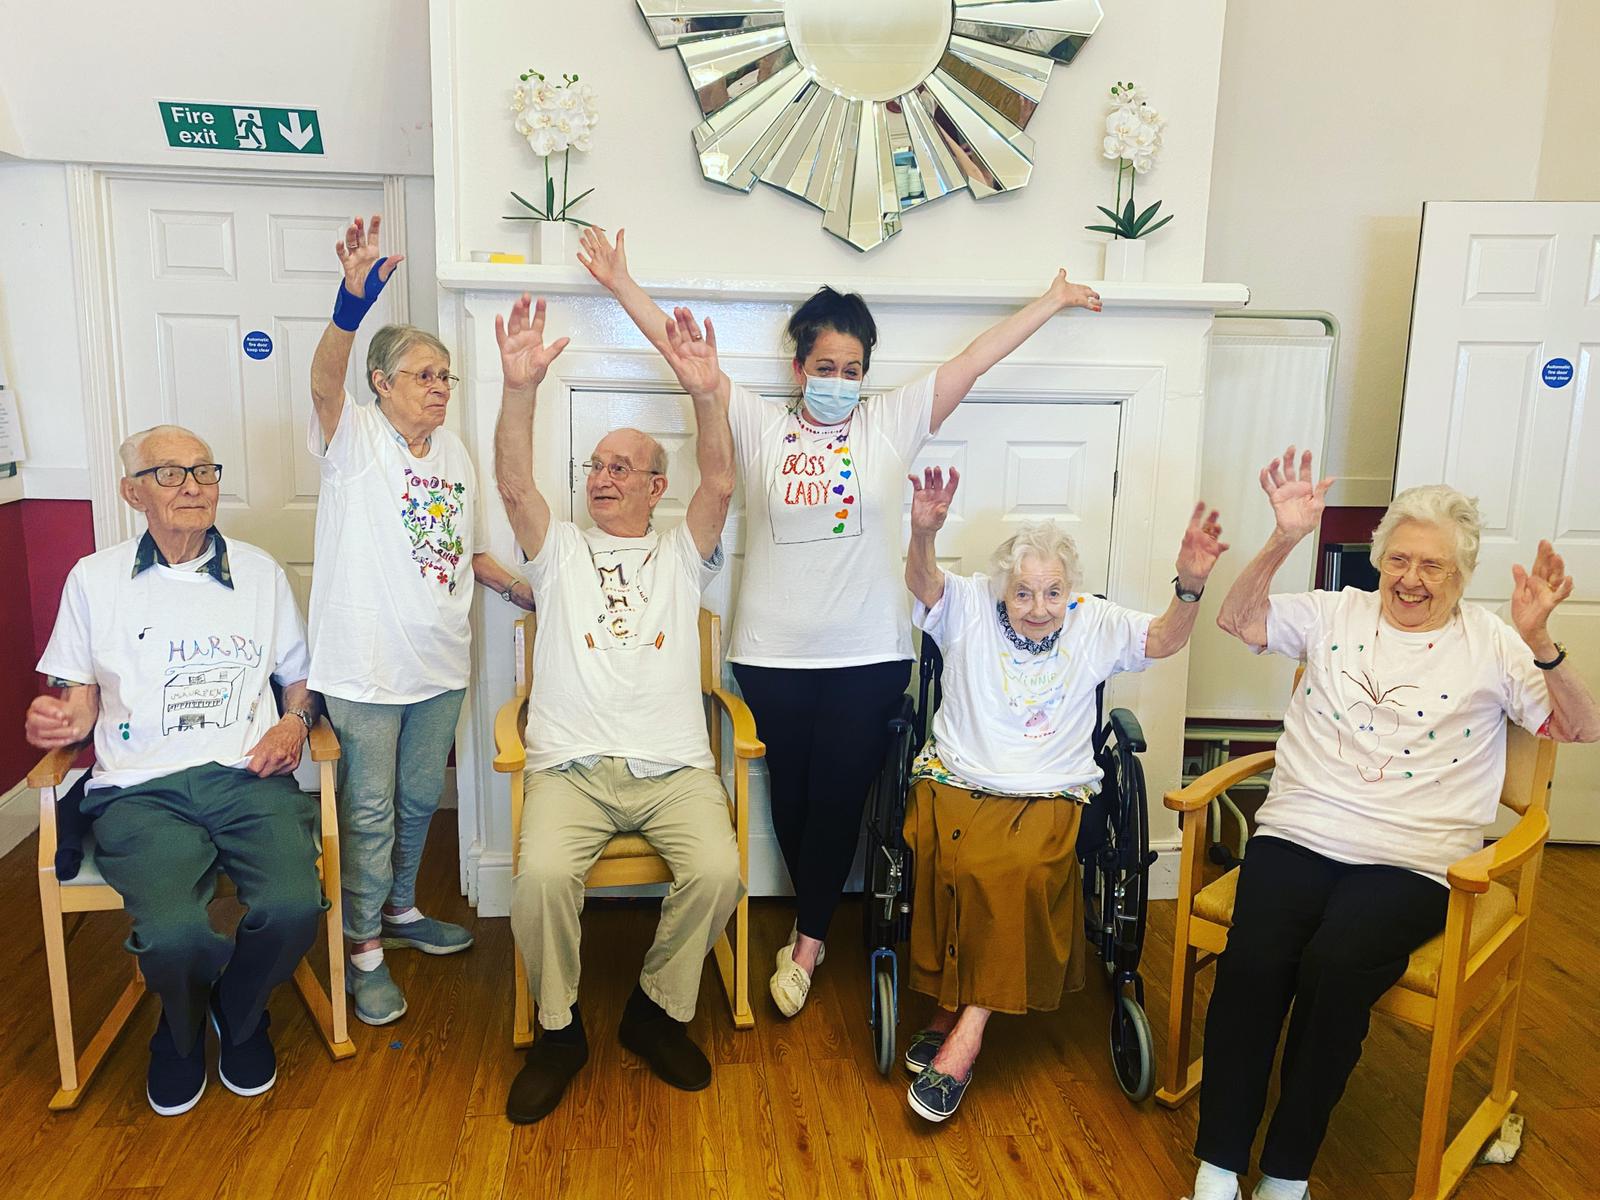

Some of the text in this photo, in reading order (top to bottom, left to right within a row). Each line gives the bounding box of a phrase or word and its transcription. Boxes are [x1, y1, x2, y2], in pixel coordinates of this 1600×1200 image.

[170, 106, 215, 125] Fire
[178, 128, 218, 145] exit
[782, 452, 825, 476] BOSS
[784, 479, 832, 506] LADY
[168, 635, 263, 666] HARRY
